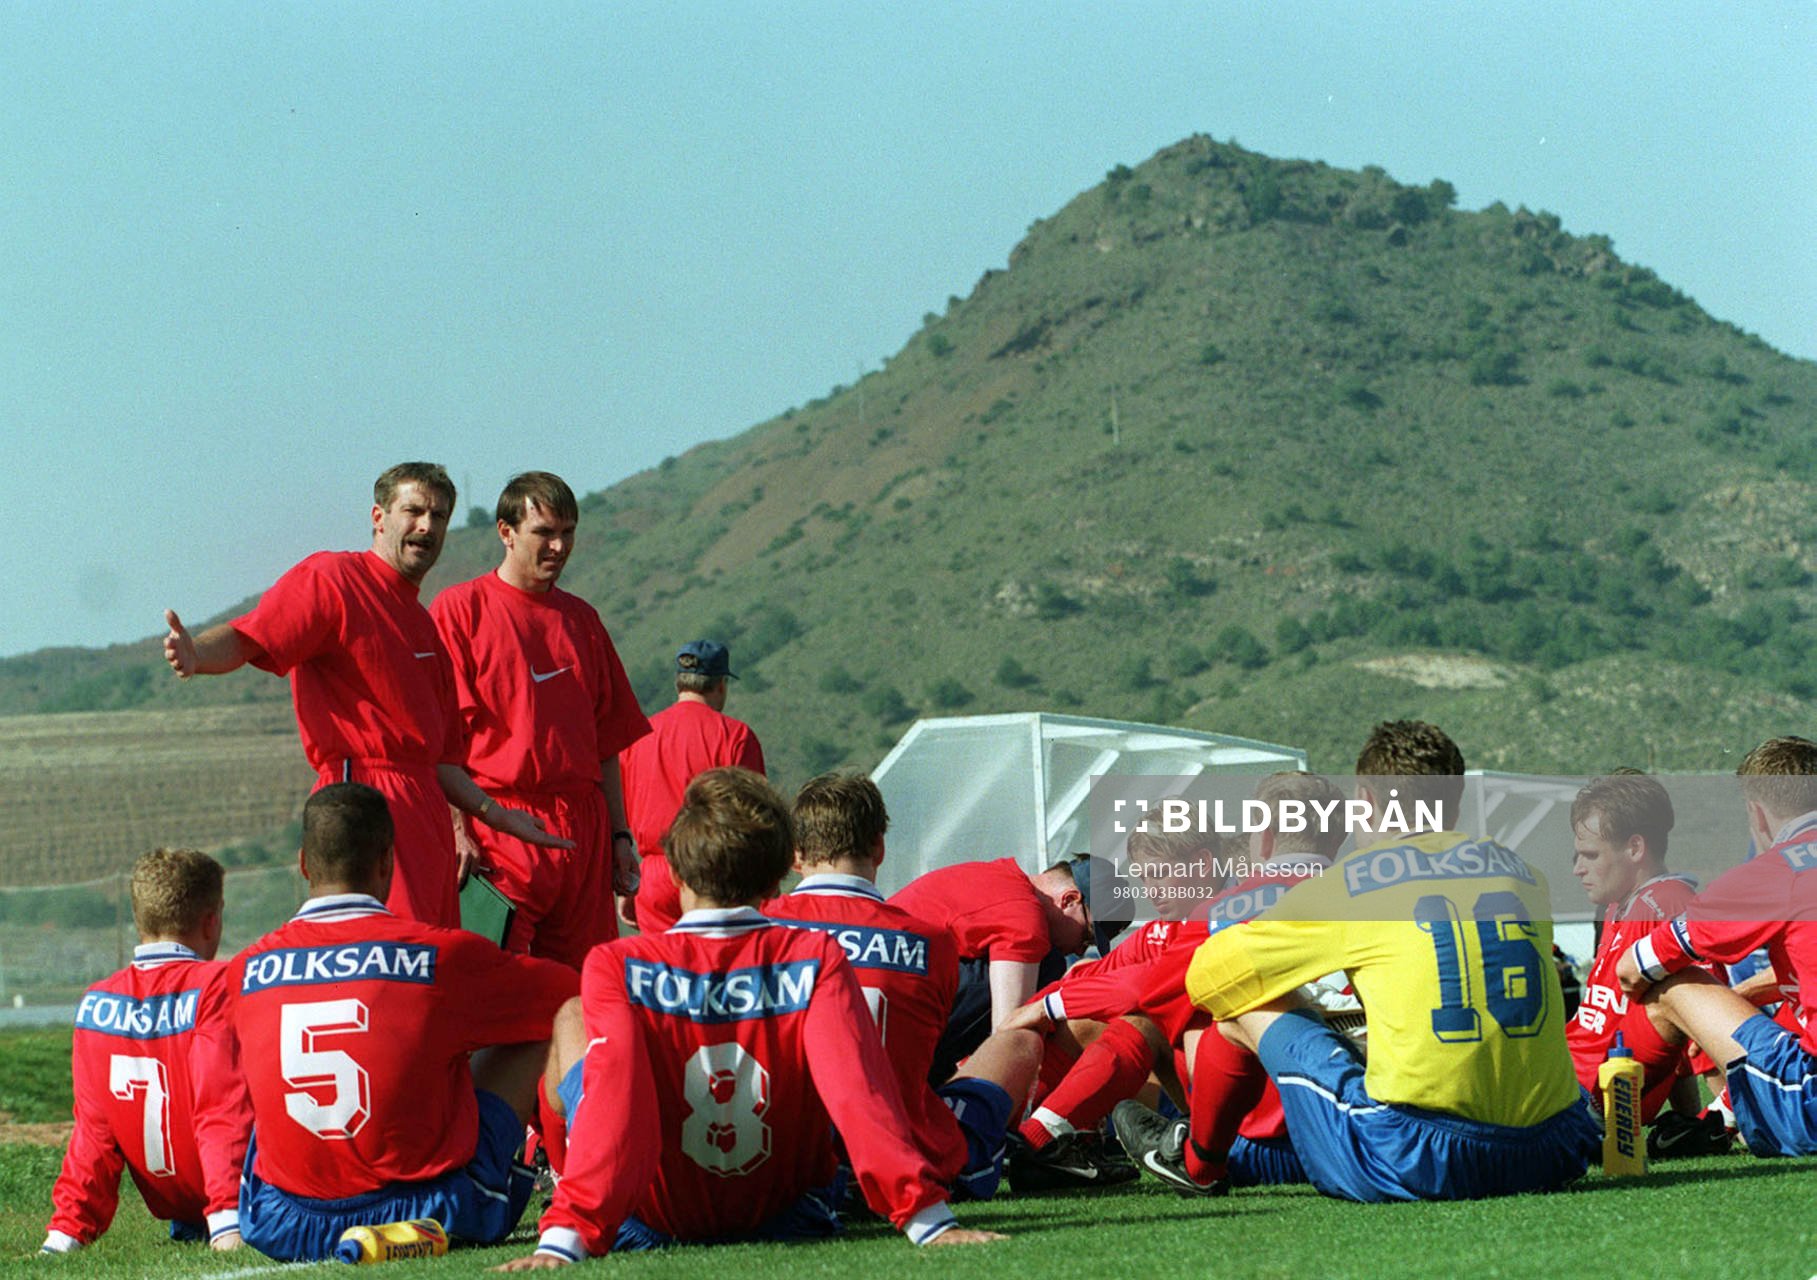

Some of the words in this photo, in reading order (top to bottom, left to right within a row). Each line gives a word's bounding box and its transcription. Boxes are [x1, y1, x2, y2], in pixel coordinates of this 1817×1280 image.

[1346, 844, 1535, 891] FOLKSAM
[1209, 886, 1286, 931] FOL
[242, 946, 431, 991] FOLKSAM
[630, 964, 815, 1017] FOLKSAM
[1413, 892, 1548, 1044] 16
[76, 994, 196, 1034] FOLKSAM
[280, 998, 370, 1140] 5
[110, 1054, 175, 1177] 7
[682, 1042, 772, 1178] 8
[1614, 1075, 1635, 1159] ENERGY
